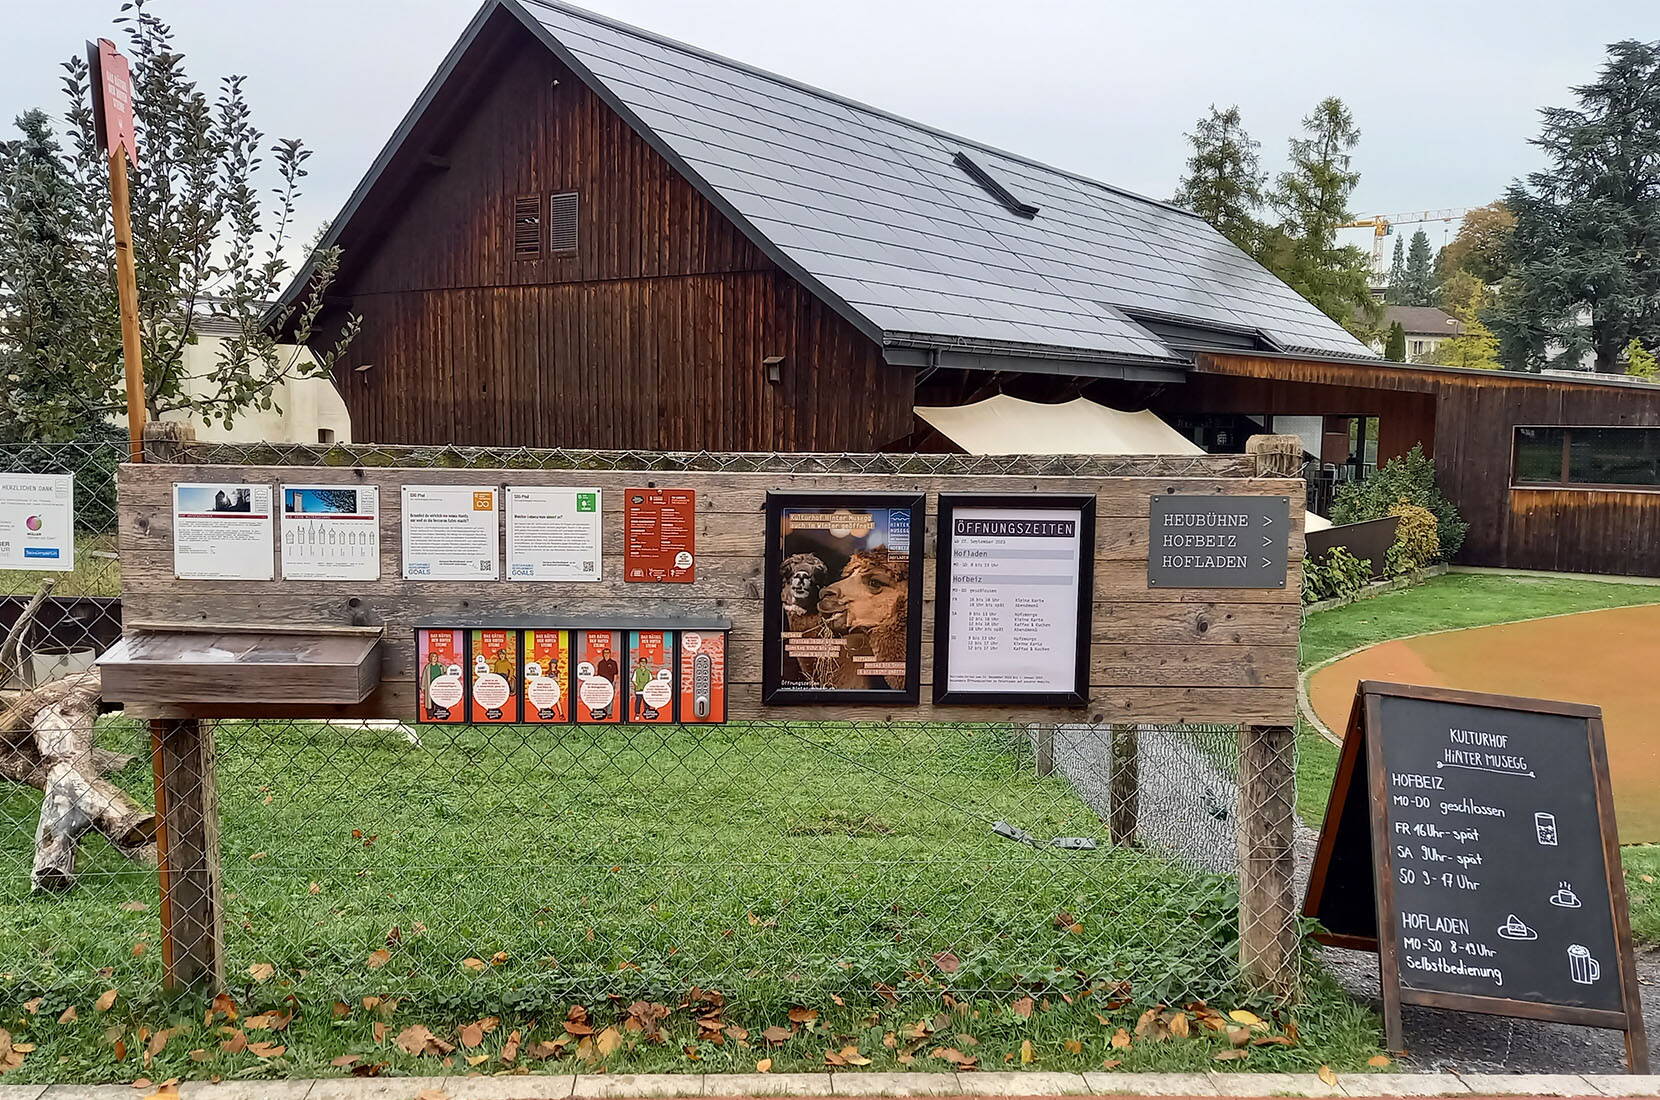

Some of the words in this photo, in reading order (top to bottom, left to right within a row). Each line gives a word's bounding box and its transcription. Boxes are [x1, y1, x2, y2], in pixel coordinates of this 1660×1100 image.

[957, 520, 1072, 535] ÖFFNUNGSZEITEN
[1164, 512, 1248, 526] HEUBÜHNE
[1163, 535, 1237, 547] HOFBEIZ
[1162, 556, 1248, 568] HOFLADEN
[953, 575, 982, 583] Hofbeiz
[1450, 728, 1508, 748] KULTURHOF
[1485, 753, 1527, 770] MUSEGG
[1392, 773, 1445, 790] HOFBEIZ
[1393, 795, 1430, 808] MO-DO
[1439, 798, 1506, 817] geschlossen
[1395, 822, 1411, 835] FR
[1452, 828, 1480, 844] spät
[1397, 845, 1414, 859] SA
[1457, 853, 1483, 869] spät
[1399, 868, 1415, 884] SO
[1456, 874, 1480, 890] Uhr
[1401, 912, 1469, 935] HOFLADEN
[1403, 937, 1442, 952] MO-SO
[1406, 956, 1503, 986] Selbstbedienung
